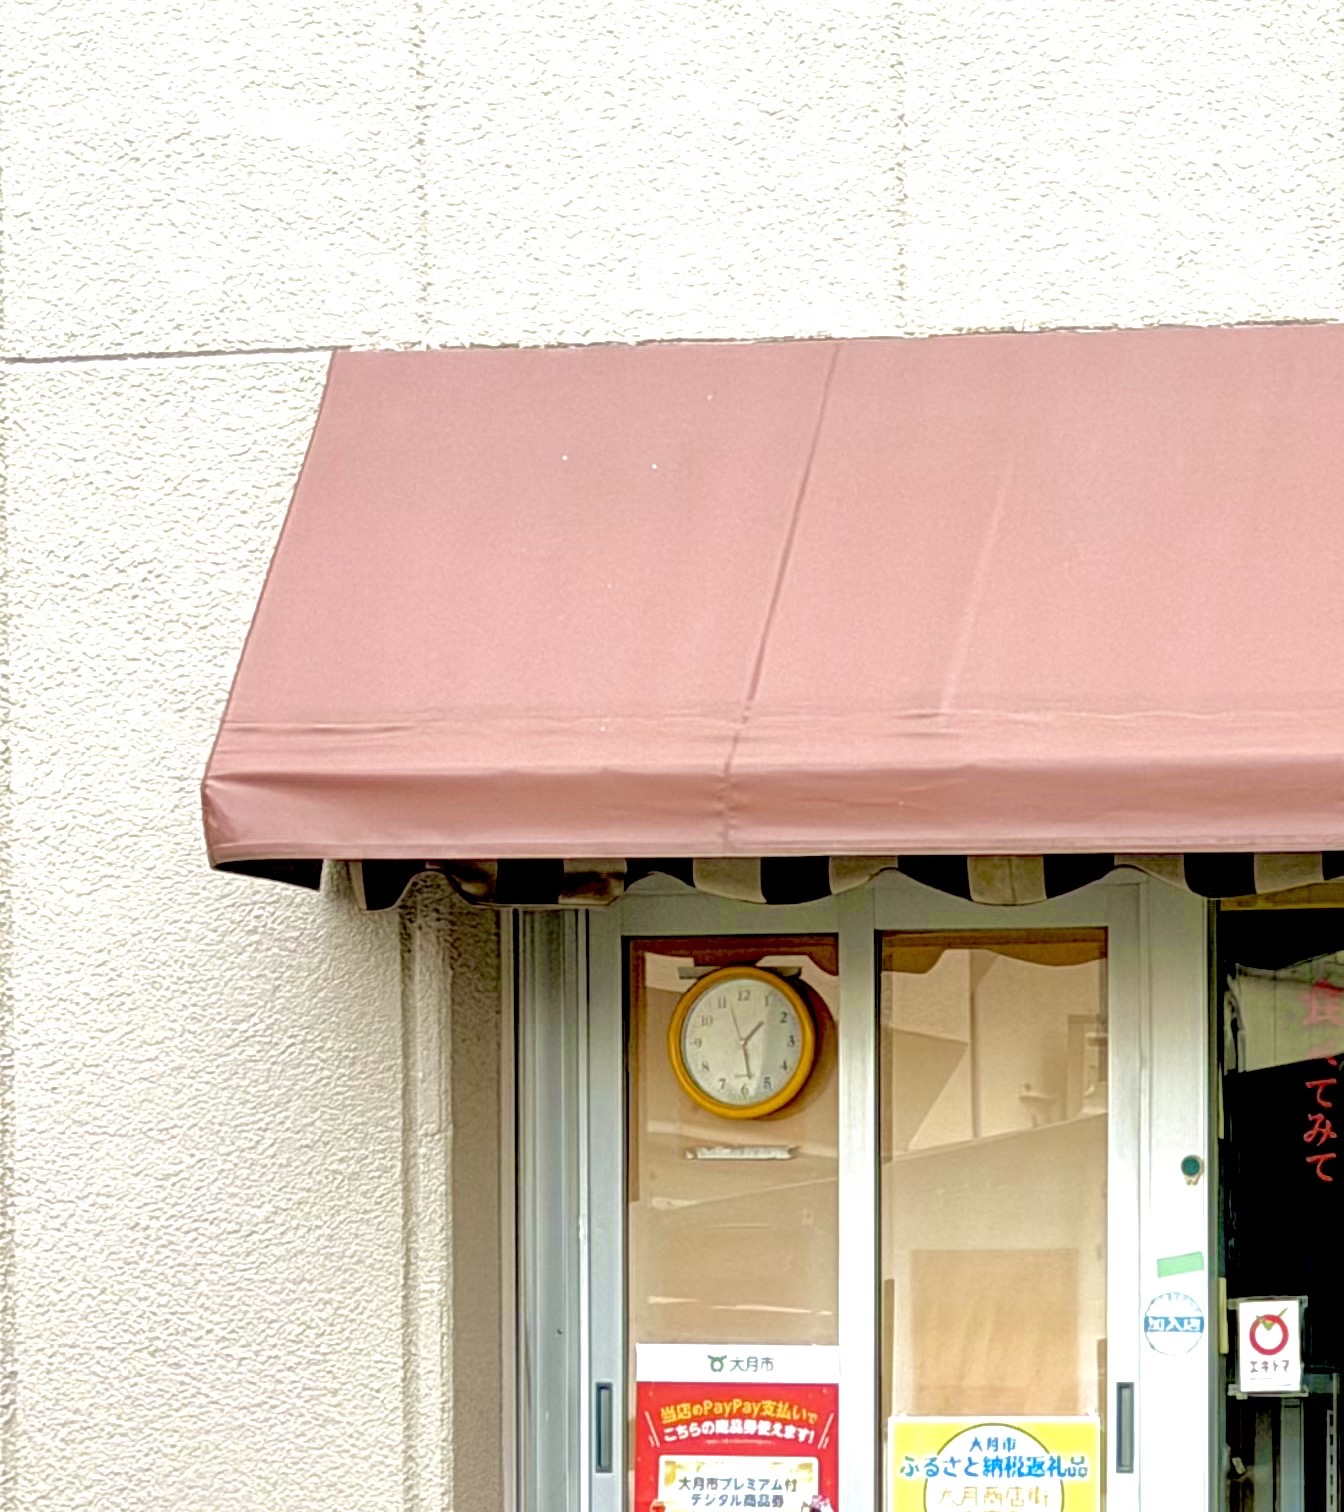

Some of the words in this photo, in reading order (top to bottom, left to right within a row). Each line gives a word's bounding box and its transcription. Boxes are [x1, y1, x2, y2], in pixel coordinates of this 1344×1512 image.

[737, 990, 751, 1001] 12
[764, 993, 770, 1007] 1
[717, 996, 728, 1009] 11
[700, 1015, 714, 1027] 10
[780, 1011, 788, 1023] 2
[694, 1038, 702, 1048] 9
[787, 1035, 795, 1047] 3
[701, 1061, 710, 1072] 8
[780, 1060, 788, 1071] 4
[718, 1078, 727, 1090] 7
[740, 1084, 749, 1096] 6
[763, 1077, 771, 1090] 5
[729, 1356, 774, 1373] 大月市
[660, 1398, 819, 1425] 当店のPayPay支払いで
[969, 1437, 1016, 1452] 大月市
[899, 1455, 1089, 1478] ふるさと納税返礼品
[678, 1477, 798, 1492] 大月市プレミアム付
[691, 1493, 785, 1508] デジタル商品券
[938, 1486, 1049, 1508] 大月商店街
